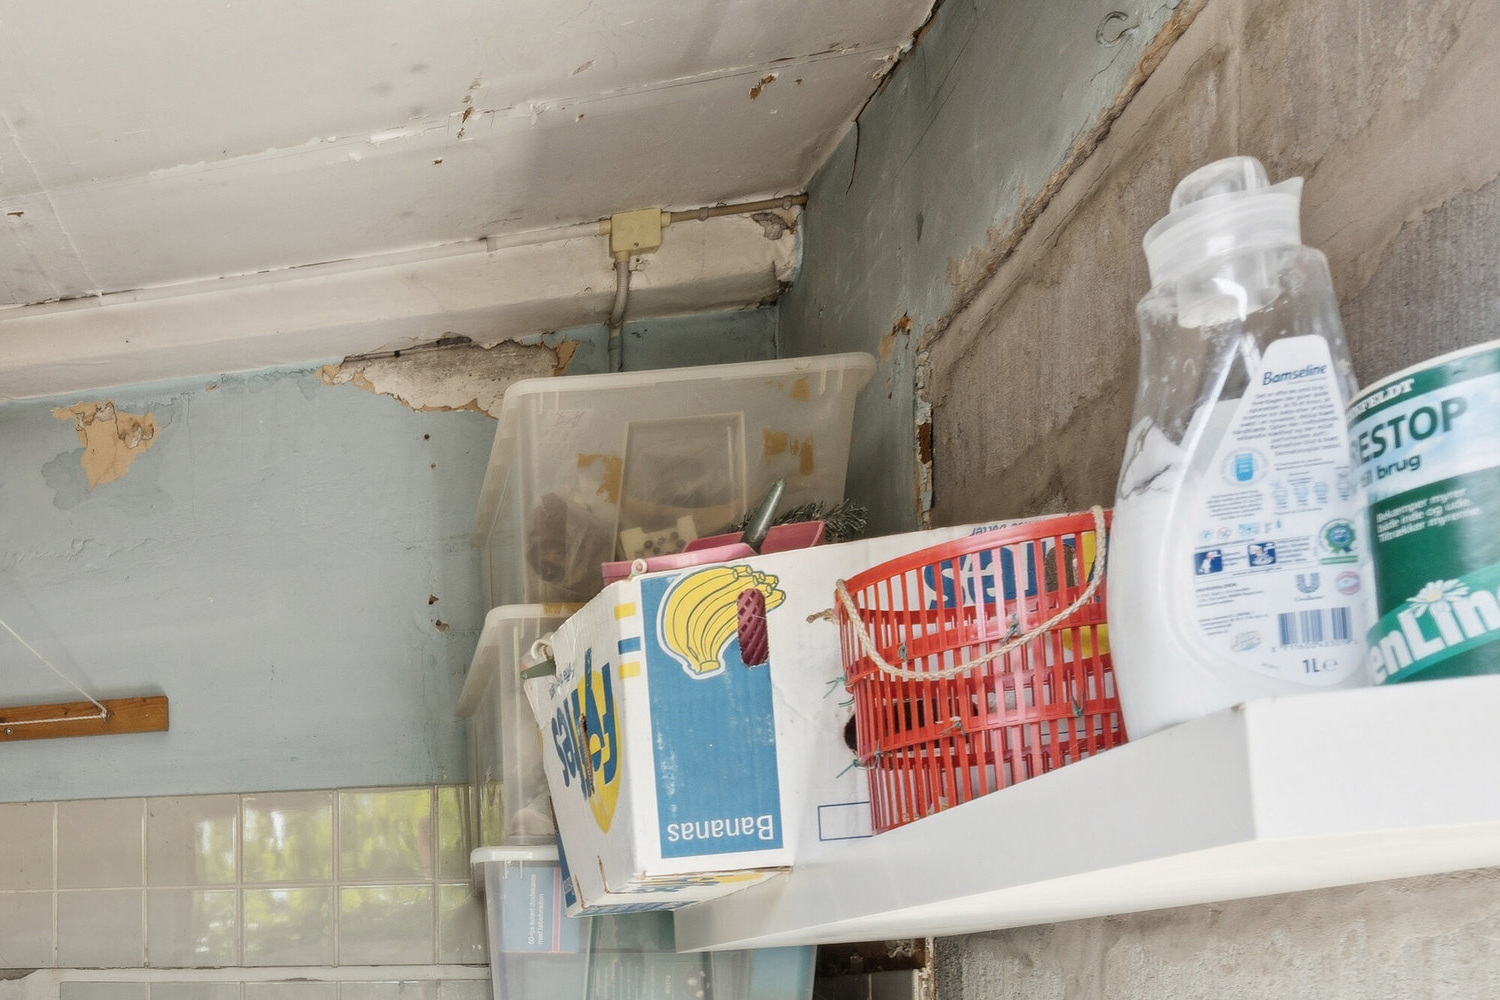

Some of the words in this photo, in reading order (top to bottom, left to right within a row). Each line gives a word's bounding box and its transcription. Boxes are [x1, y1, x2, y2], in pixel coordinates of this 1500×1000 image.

[1262, 364, 1328, 386] Bamseline
[1376, 454, 1421, 481] brug
[1368, 582, 1500, 686] enLin
[666, 813, 774, 844] Bananas
